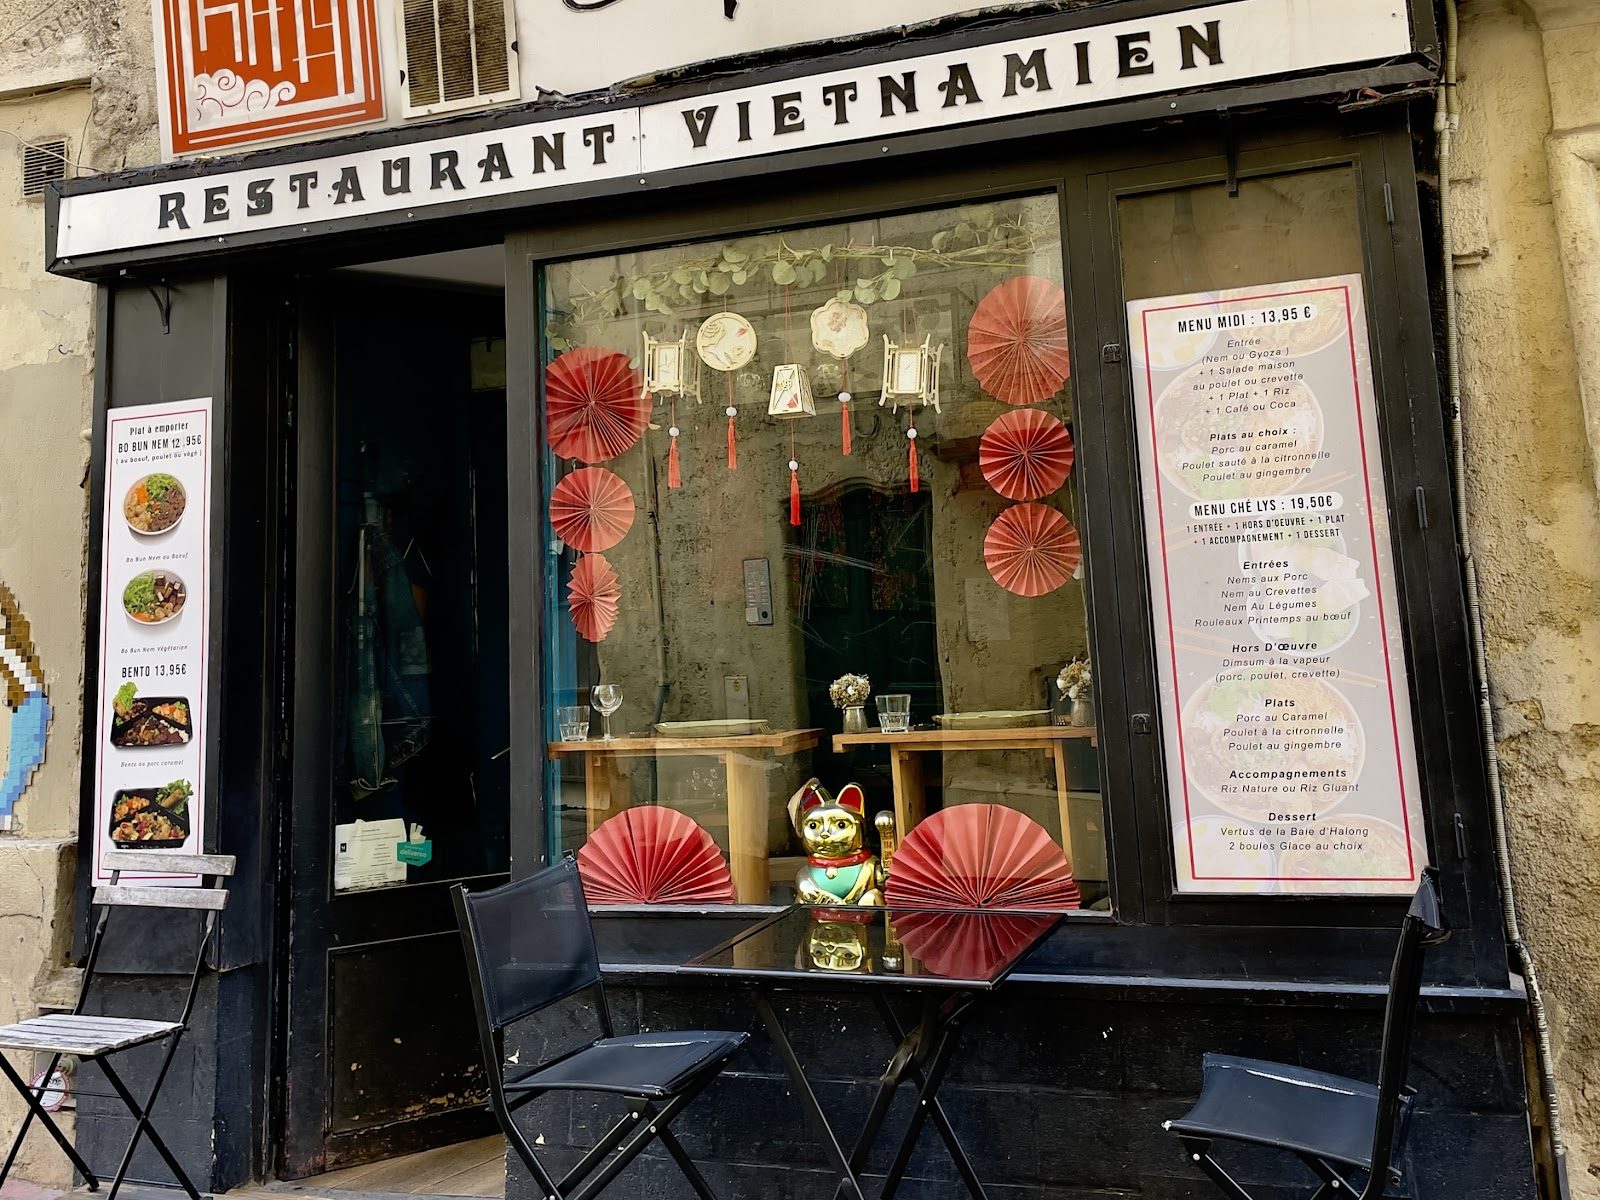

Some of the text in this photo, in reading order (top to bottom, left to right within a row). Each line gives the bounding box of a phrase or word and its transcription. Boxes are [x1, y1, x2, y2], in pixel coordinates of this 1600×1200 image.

[156, 19, 1225, 231] RESTAURANT VIETNAMIEN
[1178, 320, 1212, 333] MENU
[1218, 314, 1245, 328] MIDI
[1261, 307, 1298, 323] 13,95
[1227, 338, 1261, 348] Entrée
[1202, 354, 1228, 365] (Nem
[1232, 352, 1245, 361] ou
[1249, 349, 1281, 361] Gyoza
[1219, 365, 1253, 375] Salade
[1258, 361, 1295, 370] maison
[1193, 383, 1205, 391] au
[1208, 379, 1240, 391] poulet
[1261, 373, 1303, 384] crevette
[1228, 392, 1249, 400] Plat
[1274, 388, 1290, 396] Riz
[1225, 404, 1249, 414] Café
[1270, 401, 1296, 409] Coca
[130, 427, 145, 435] Plat
[155, 423, 188, 433] emporter
[1210, 433, 1237, 442] Plats
[1241, 431, 1254, 439] au
[1258, 428, 1288, 437] choix
[118, 444, 128, 453] BO
[132, 441, 148, 451] BUN
[152, 439, 168, 449] NEM
[1211, 441, 1297, 455] Porc au caramel
[1182, 461, 1215, 471] Poulet
[1219, 458, 1247, 467] sauté
[1261, 456, 1270, 464] la
[1274, 451, 1330, 463] citronnelle
[1203, 472, 1235, 482] Poulet
[1256, 466, 1312, 479] gingembre
[1194, 503, 1225, 516] MENU
[1231, 499, 1252, 513] CHÉ
[1257, 500, 1276, 512] LYS
[1290, 496, 1333, 509] 19,50€
[1194, 523, 1223, 533] ENTRÉE
[1242, 520, 1263, 529] HORS
[1266, 517, 1306, 528] D'OEUVRE
[1326, 515, 1345, 524] PLAT
[1210, 532, 1284, 545] ACCOMPAGNEMENT
[1304, 529, 1339, 539] DESSERT
[1243, 560, 1289, 570] Entrées
[1227, 575, 1256, 585] Nems
[1284, 573, 1308, 581] Porc
[1221, 586, 1317, 598] Nem au Crevettes
[1224, 600, 1317, 612] Nem Au Légumes
[1195, 618, 1243, 628] Rouleaux
[1248, 615, 1301, 625] Printemps
[1306, 614, 1318, 622] au
[1232, 644, 1260, 653] Hors
[1223, 658, 1264, 667] Dimsum
[1279, 657, 1288, 665] la
[1293, 656, 1330, 666] vapeur
[122, 664, 187, 678] BENTO 13,95€
[1215, 669, 1340, 682] (porc, poulet, crevette)
[1265, 699, 1295, 707] Plats
[1236, 714, 1260, 722] Porc
[1282, 712, 1328, 721] Caramel
[1224, 729, 1257, 737] Poulet
[1286, 727, 1344, 735] citronnelle
[1228, 741, 1341, 751] Poulet au gingembre
[1229, 769, 1347, 780] Accompagnements
[1221, 785, 1237, 793] Riz
[1300, 784, 1317, 792] Riz
[1323, 784, 1359, 792] Gluant
[1268, 813, 1317, 821] Dessert
[1221, 828, 1254, 836] Vertus
[1319, 828, 1368, 837] d'Halong
[1239, 842, 1275, 850] boules
[1280, 842, 1311, 850] Glace
[1334, 842, 1363, 850] choix
